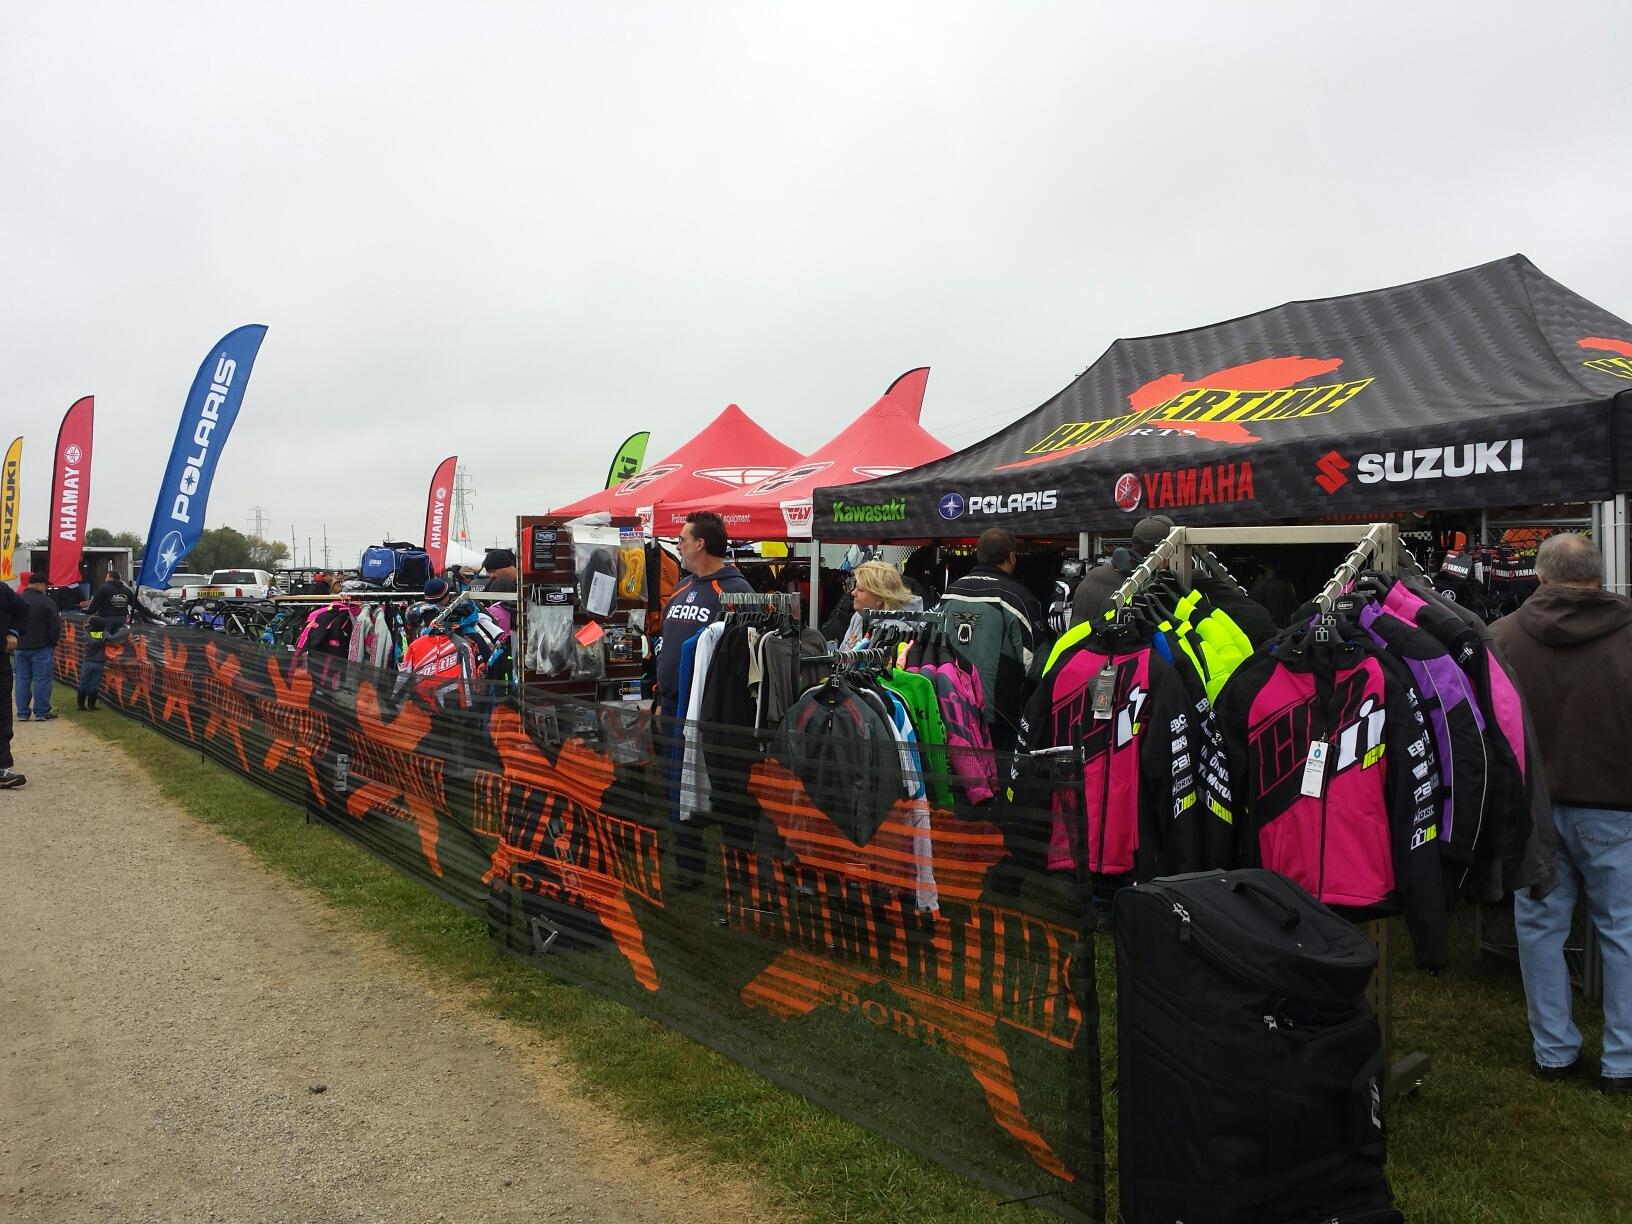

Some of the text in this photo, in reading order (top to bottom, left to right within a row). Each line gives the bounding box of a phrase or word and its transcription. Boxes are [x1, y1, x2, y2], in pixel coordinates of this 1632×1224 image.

[171, 357, 237, 524] POLARIS
[1357, 438, 1524, 484] SUZUKI
[3, 461, 17, 549] SUZUKI
[968, 489, 1058, 515] POLARIS
[1144, 461, 1255, 509] YAMAHA
[832, 497, 906, 523] Kawasaki
[1447, 564, 1468, 575] YAMAHA
